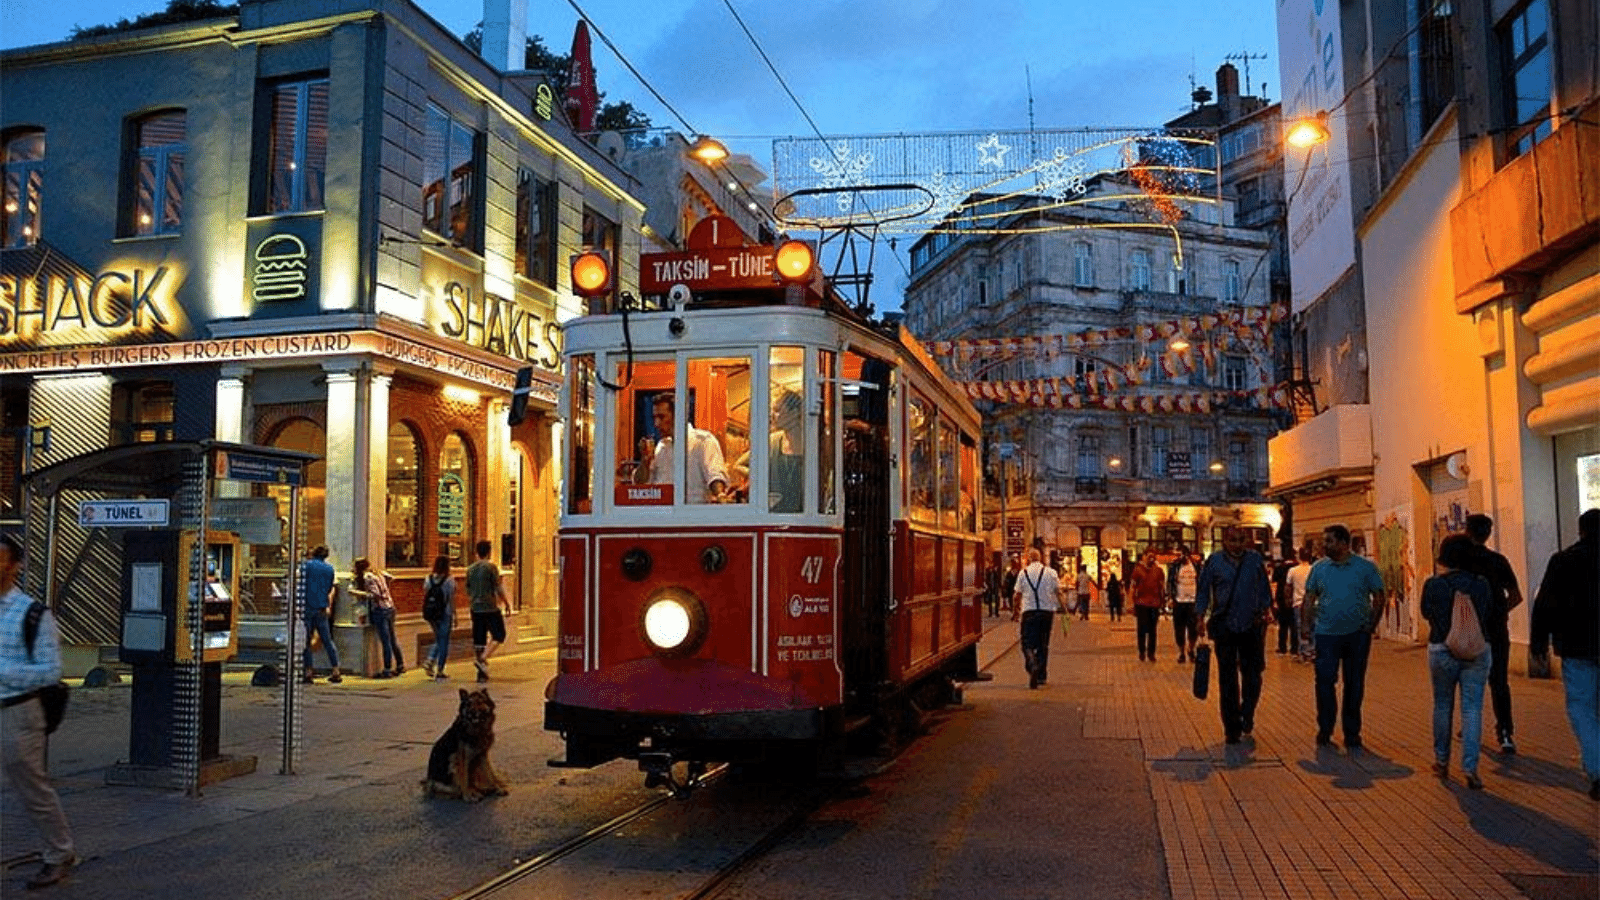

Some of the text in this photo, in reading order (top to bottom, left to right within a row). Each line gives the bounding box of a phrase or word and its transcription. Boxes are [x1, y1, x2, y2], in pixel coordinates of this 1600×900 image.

[711, 219, 718, 245] 1
[653, 255, 709, 282] TAKSİM
[729, 252, 773, 278] TÜNE
[441, 282, 561, 369] SHAKES
[0, 333, 351, 370] NCRETES BURGERS FROZEN CUSTARD
[105, 504, 144, 521] TÜNEL
[801, 556, 823, 584] 47
